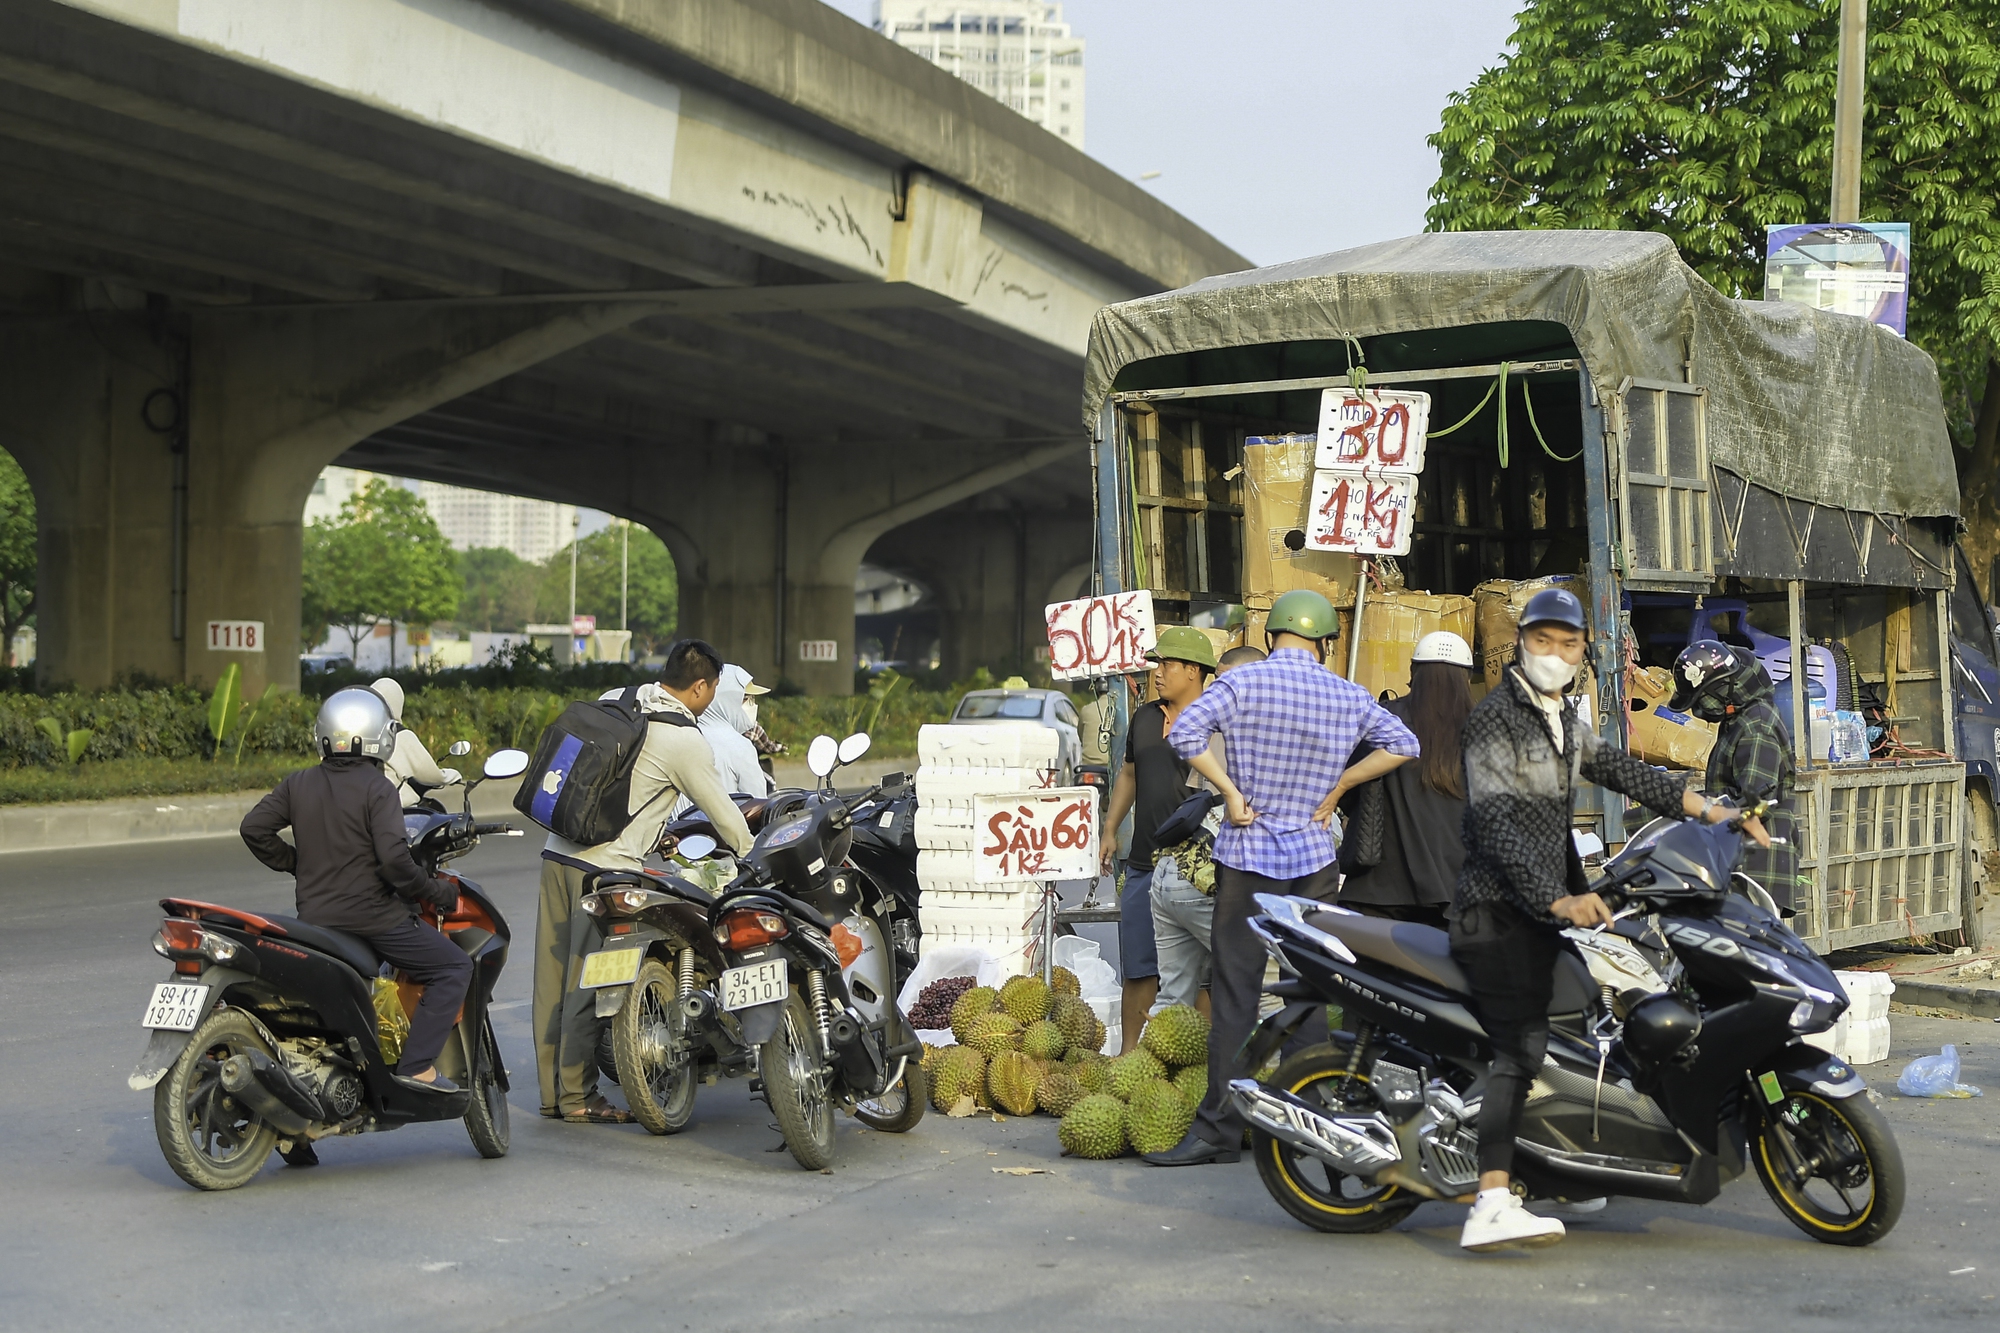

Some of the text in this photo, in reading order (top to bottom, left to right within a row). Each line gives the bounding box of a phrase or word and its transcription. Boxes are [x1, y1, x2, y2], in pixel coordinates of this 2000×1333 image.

[1336, 397, 1410, 466] 30
[210, 624, 256, 648] T118
[803, 643, 834, 658] T117
[1663, 922, 1741, 958] 150
[732, 964, 776, 988] 34-E1
[158, 986, 198, 1006] 99-K1
[727, 980, 784, 1007] 231.01
[1331, 972, 1427, 1022] AIRBLADE
[148, 1006, 196, 1027] 197.06
